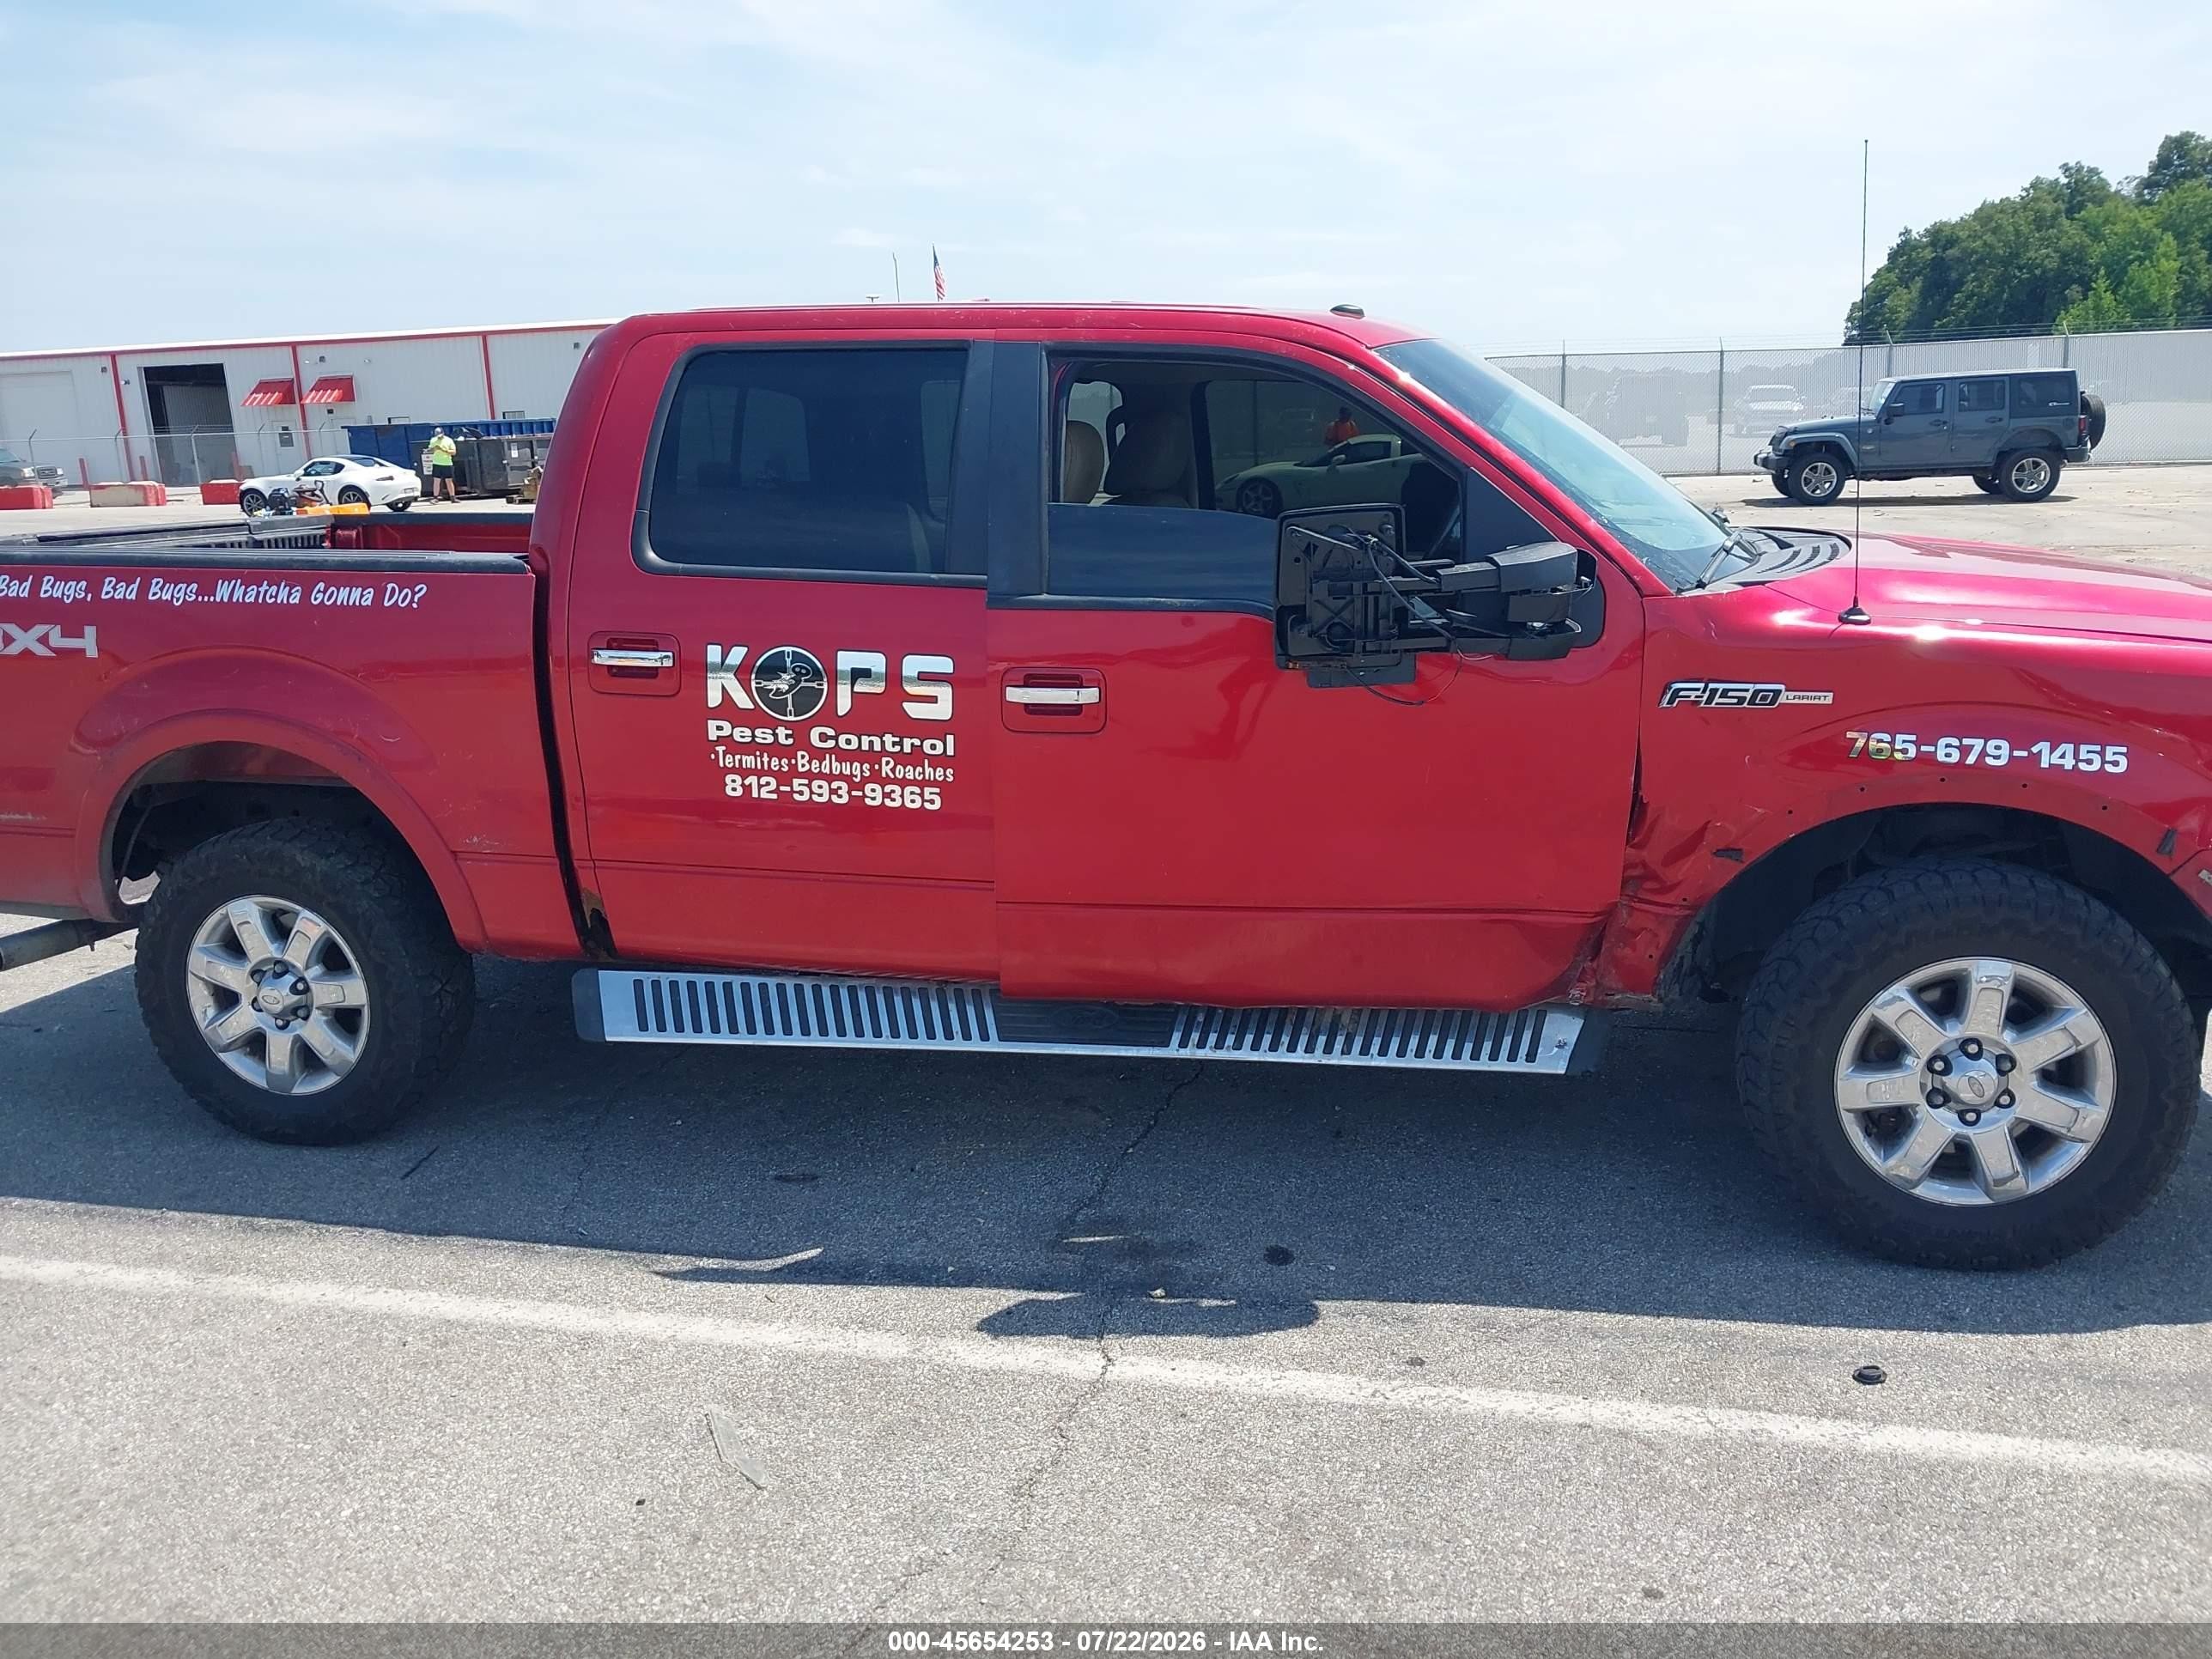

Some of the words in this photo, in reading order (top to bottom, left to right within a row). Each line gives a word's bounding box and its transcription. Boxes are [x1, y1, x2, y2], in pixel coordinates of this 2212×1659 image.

[0, 574, 33, 598] Bad
[40, 575, 92, 603] Bugs,
[101, 577, 140, 600] Bad
[311, 582, 374, 606] Gonna
[384, 583, 428, 608] Do?
[1661, 684, 1785, 708] F-150
[707, 719, 794, 746] Pest
[809, 726, 955, 757] Control
[1846, 731, 2128, 773] 765-679-1455
[724, 774, 942, 811] 812-593-9365
